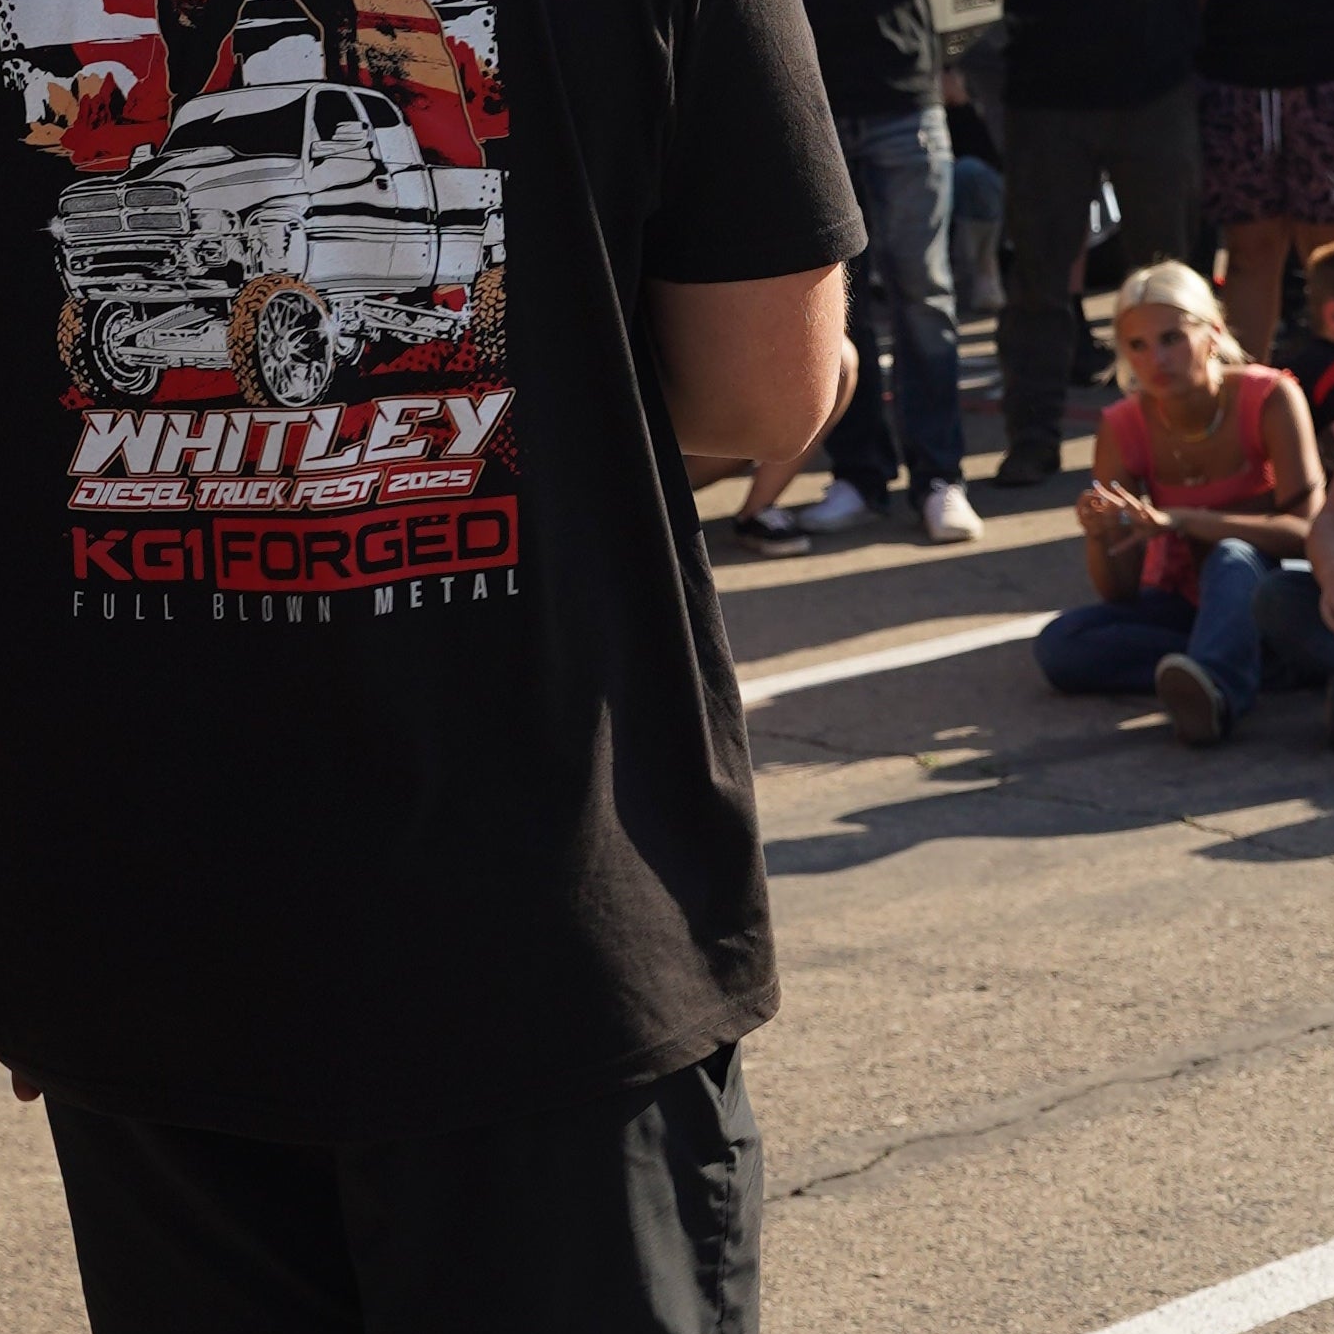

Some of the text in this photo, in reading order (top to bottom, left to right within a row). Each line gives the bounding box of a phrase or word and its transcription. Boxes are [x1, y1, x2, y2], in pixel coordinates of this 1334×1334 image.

[69, 390, 515, 475] WHITLEY
[75, 468, 473, 507] DIESEL TRUCK FEST 2025
[71, 510, 509, 581] KG1 FORGED
[72, 568, 520, 624] FULL BLOWN METAL
